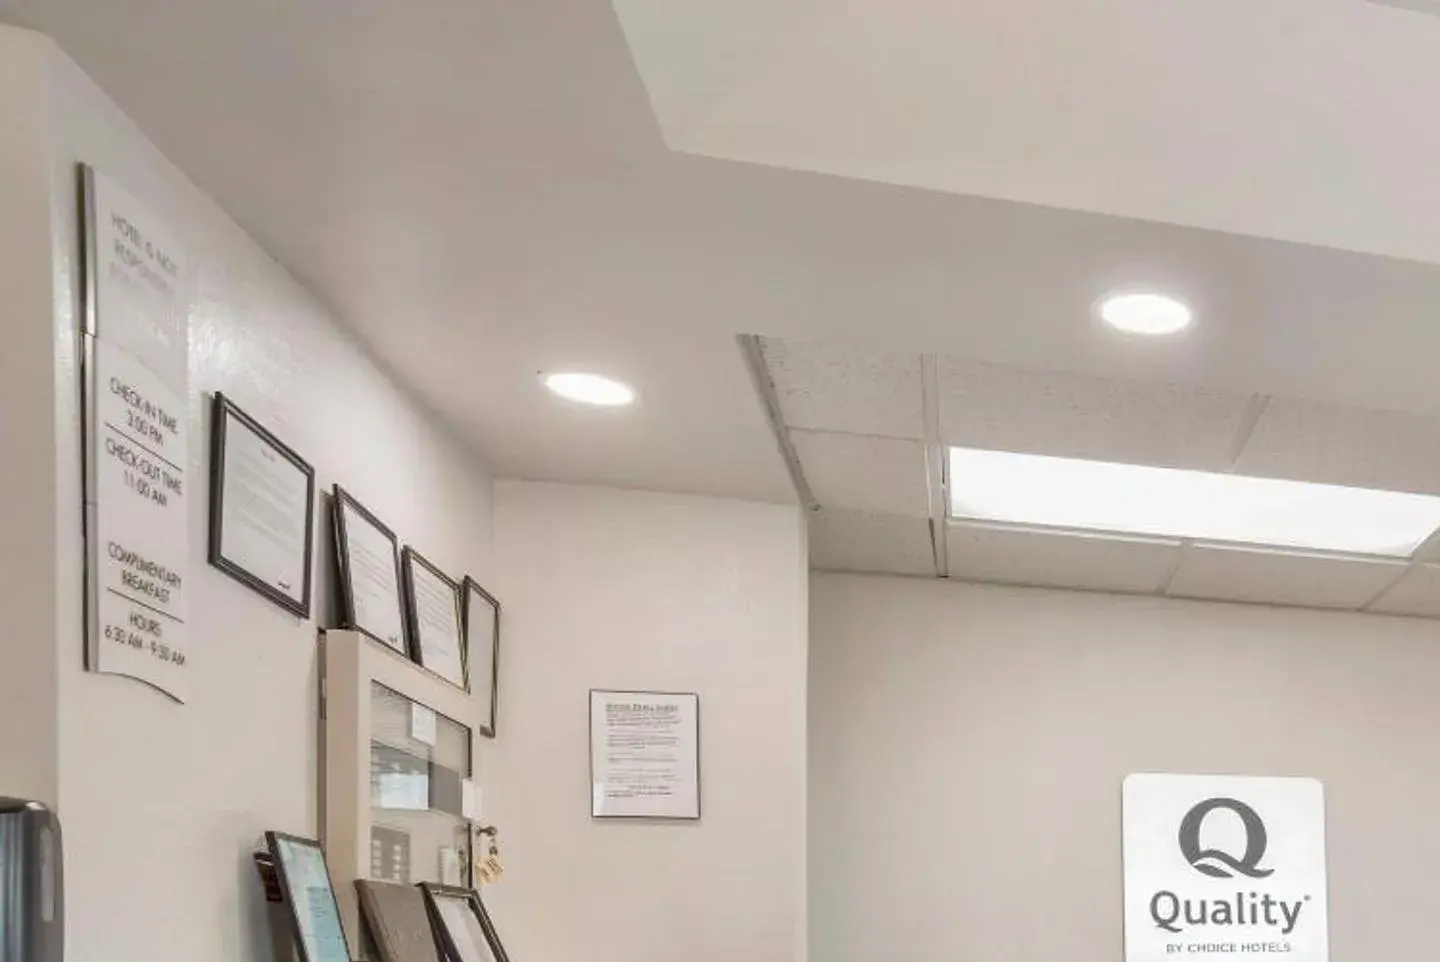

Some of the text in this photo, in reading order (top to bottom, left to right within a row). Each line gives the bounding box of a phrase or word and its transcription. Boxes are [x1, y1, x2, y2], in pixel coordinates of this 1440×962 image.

[1150, 890, 1303, 935] Quality
[1166, 942, 1292, 954] BY CHOICE HOTELS
